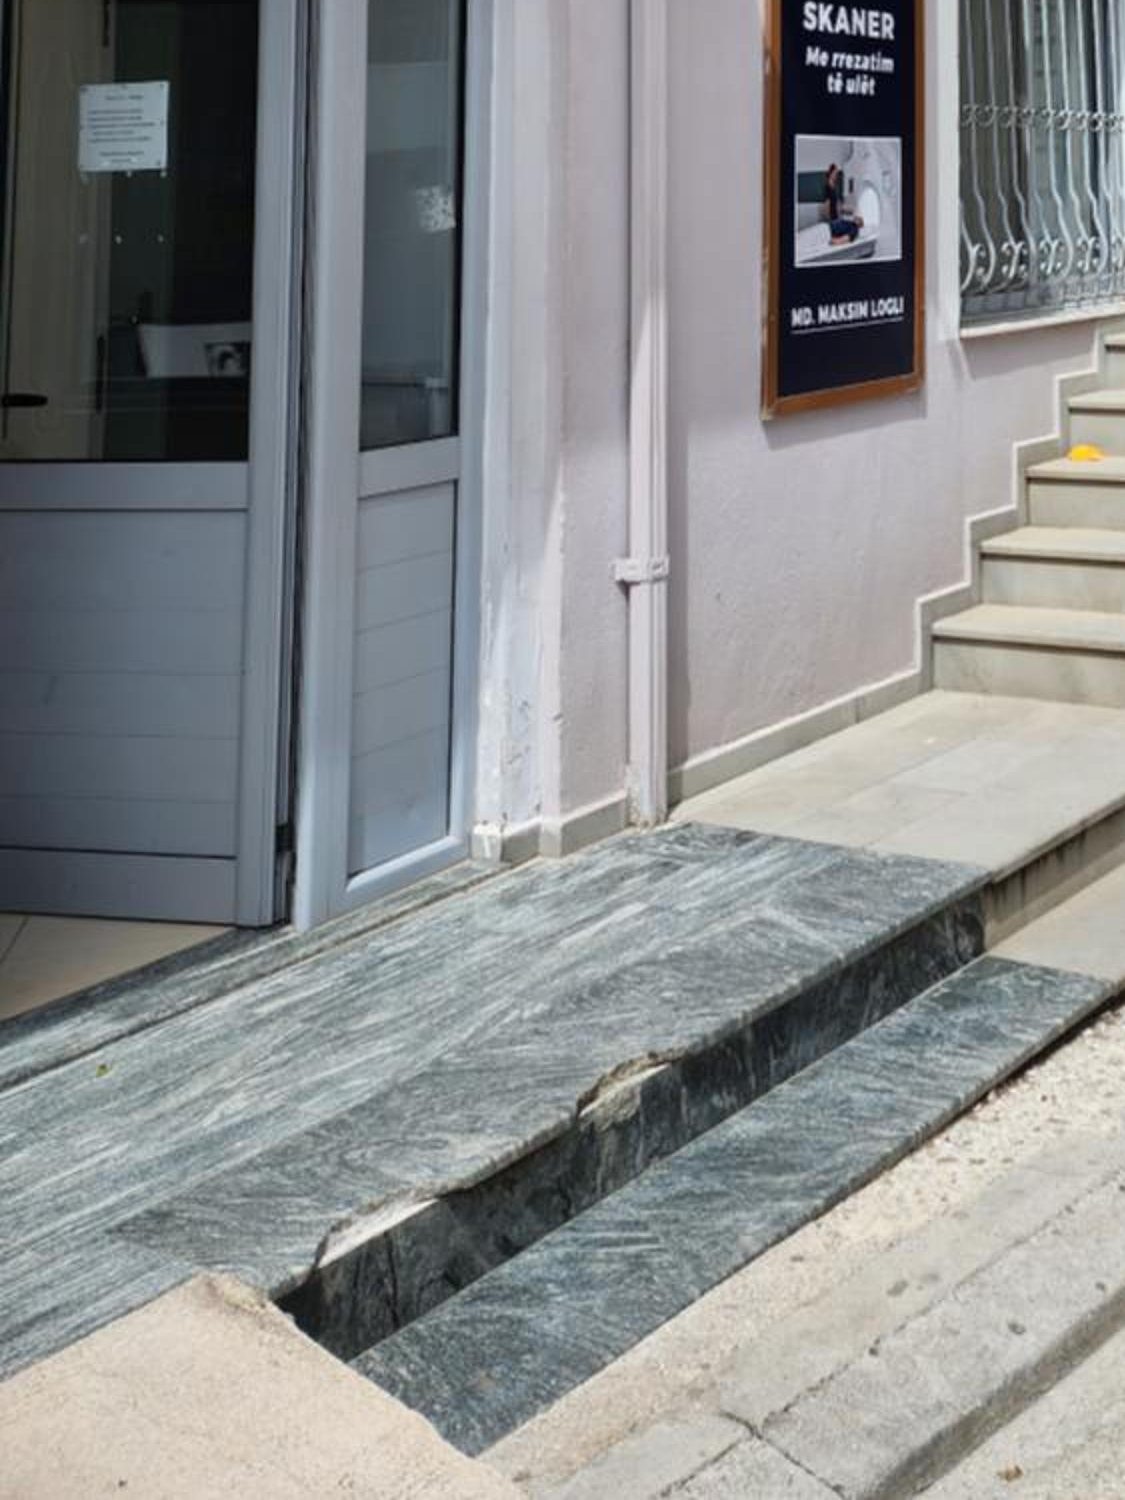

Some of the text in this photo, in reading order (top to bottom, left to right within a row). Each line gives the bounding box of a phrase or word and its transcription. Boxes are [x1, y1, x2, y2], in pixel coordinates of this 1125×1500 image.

[803, 0, 895, 40] SKANER
[805, 45, 895, 73] Me rrezatim
[827, 71, 876, 96] të ulët
[791, 296, 904, 328] MD. MAKSIM LOGLI
